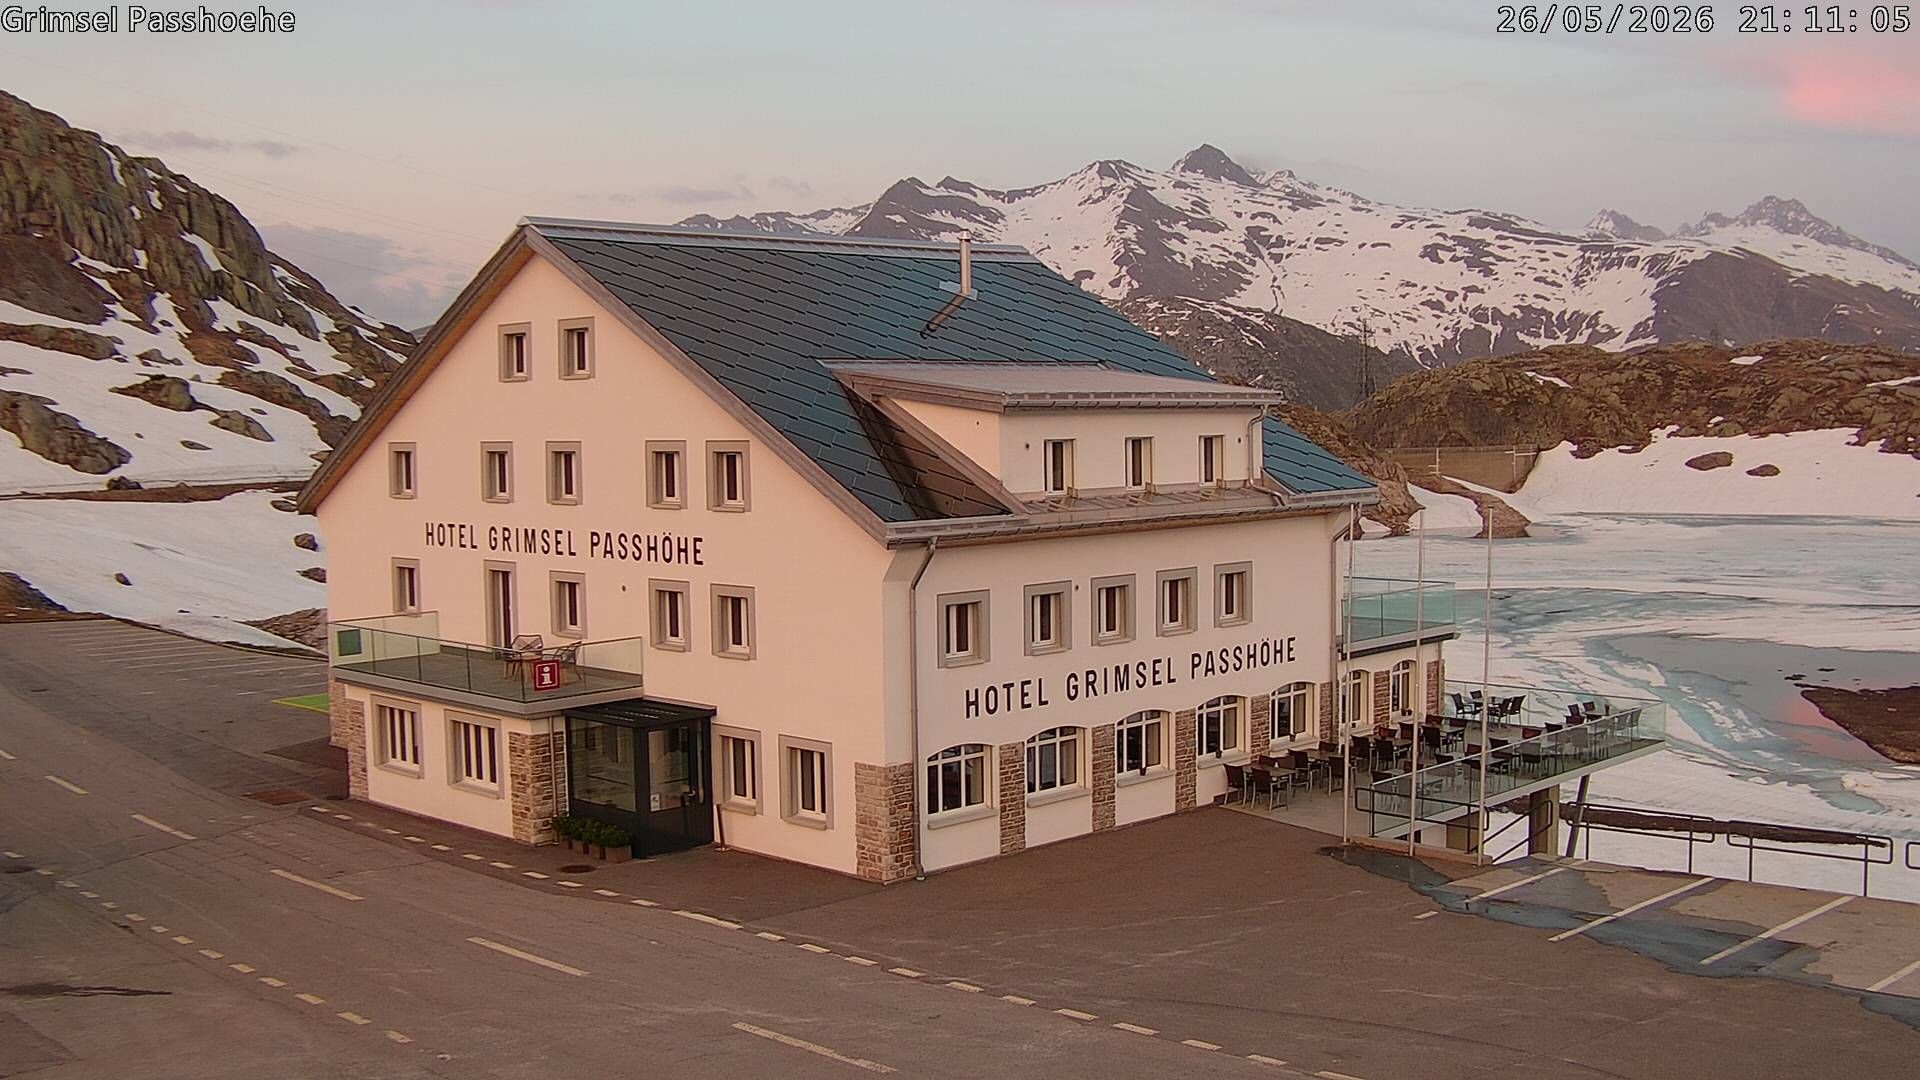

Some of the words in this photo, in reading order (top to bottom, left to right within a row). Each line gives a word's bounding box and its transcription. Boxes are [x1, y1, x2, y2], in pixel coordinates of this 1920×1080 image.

[425, 522, 478, 549] HOTEL
[489, 526, 577, 556] GRIMSEL
[590, 531, 704, 566] PASSHÖHE
[965, 678, 1049, 719] HOTEL
[1066, 658, 1177, 701] GRIMSEL
[1191, 636, 1297, 679] PASSHÖHE
